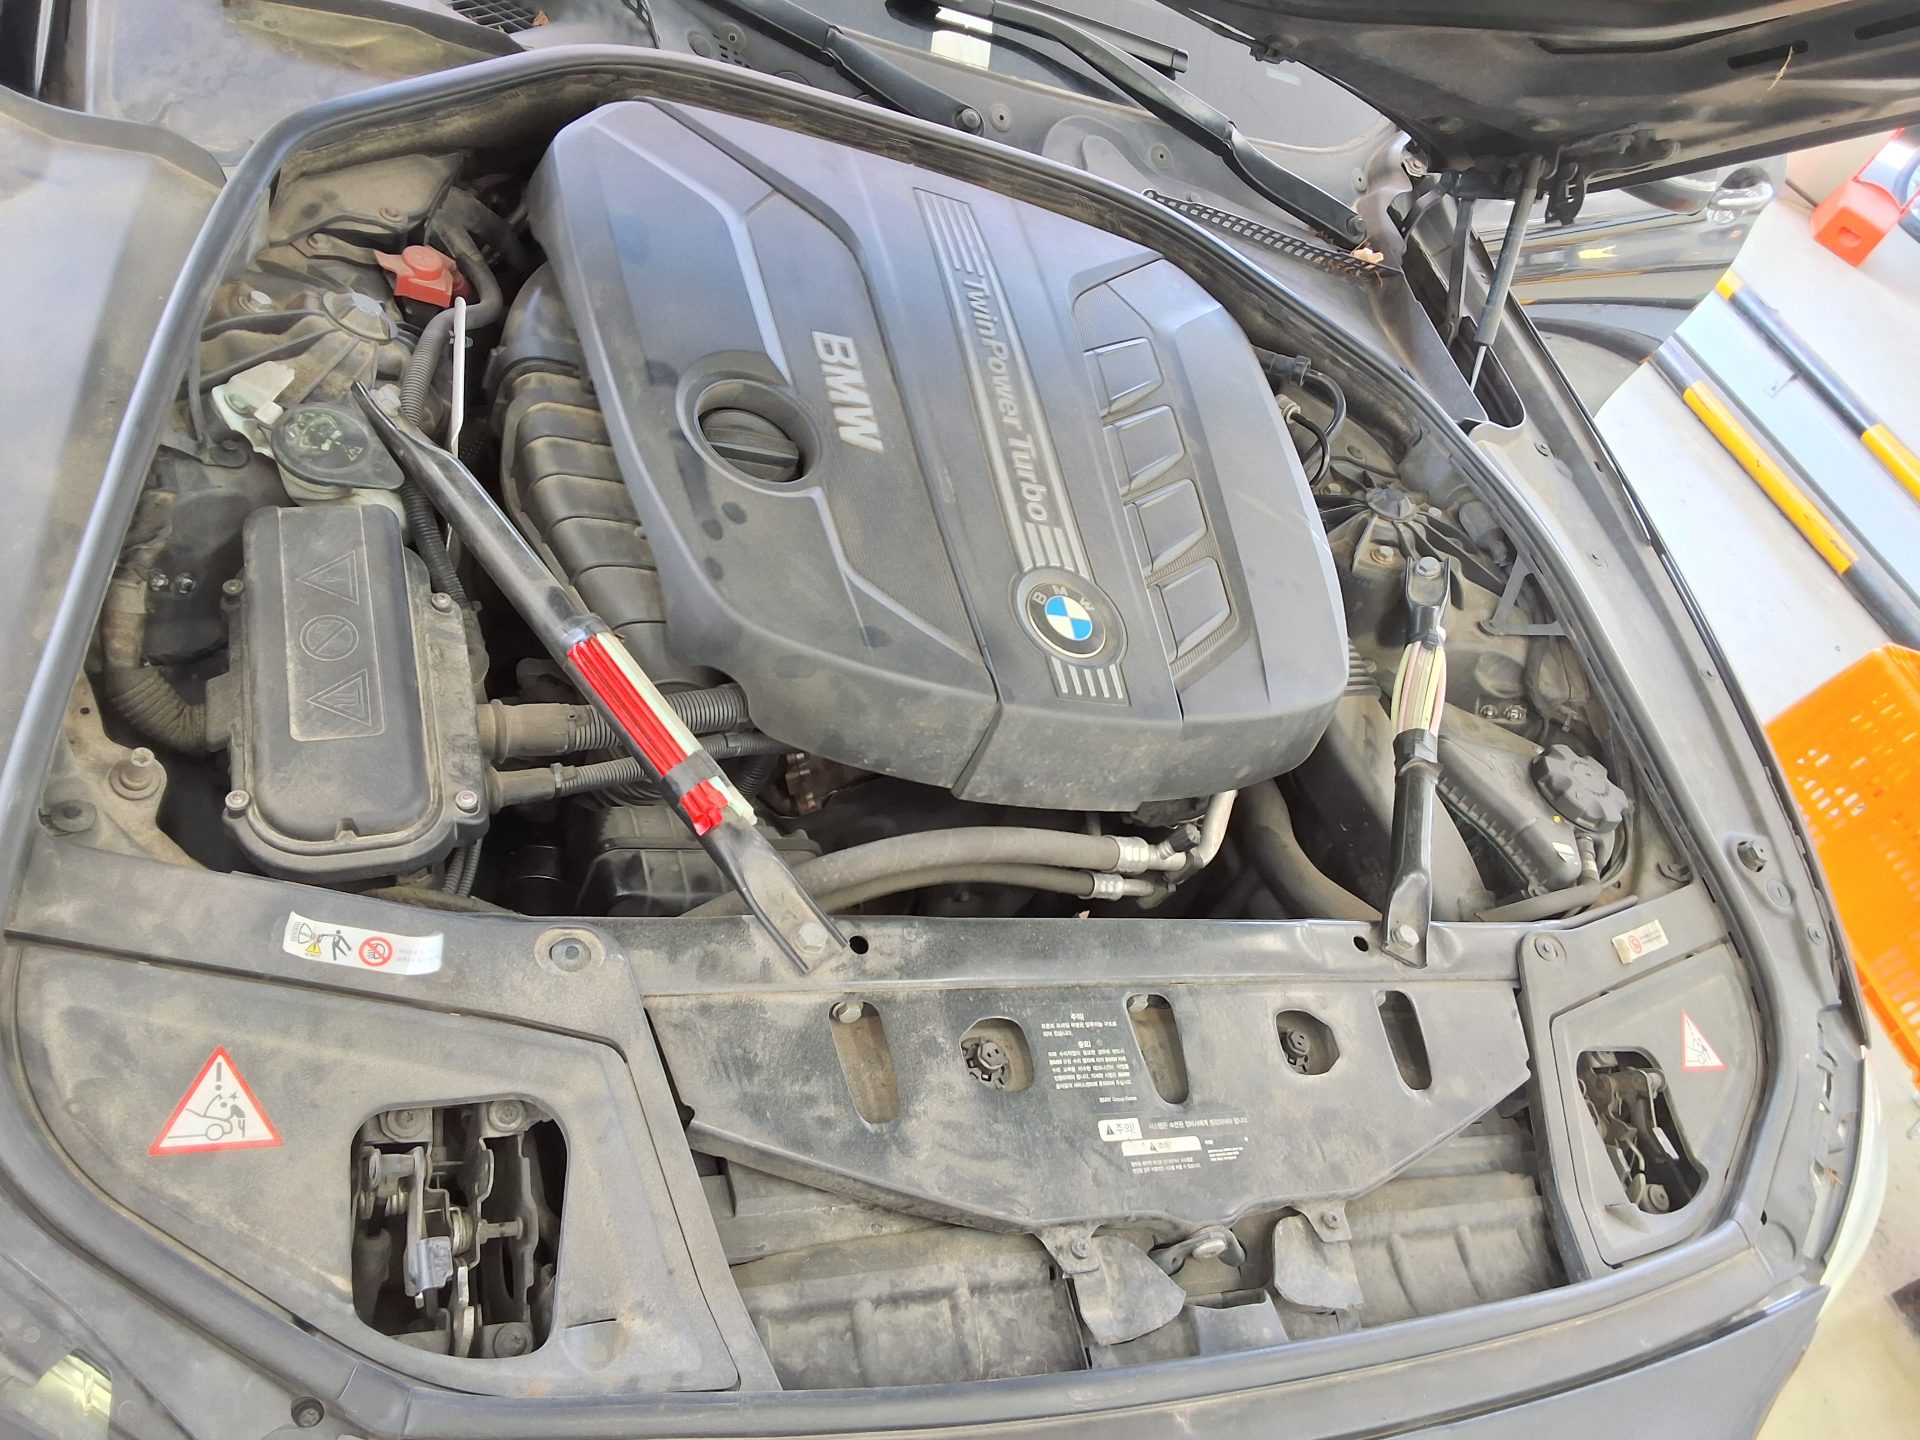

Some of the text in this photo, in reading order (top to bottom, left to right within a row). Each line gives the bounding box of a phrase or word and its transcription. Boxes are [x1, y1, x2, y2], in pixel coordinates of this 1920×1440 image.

[811, 330, 884, 453] BMW
[963, 278, 1048, 521] TwinPower Turbo
